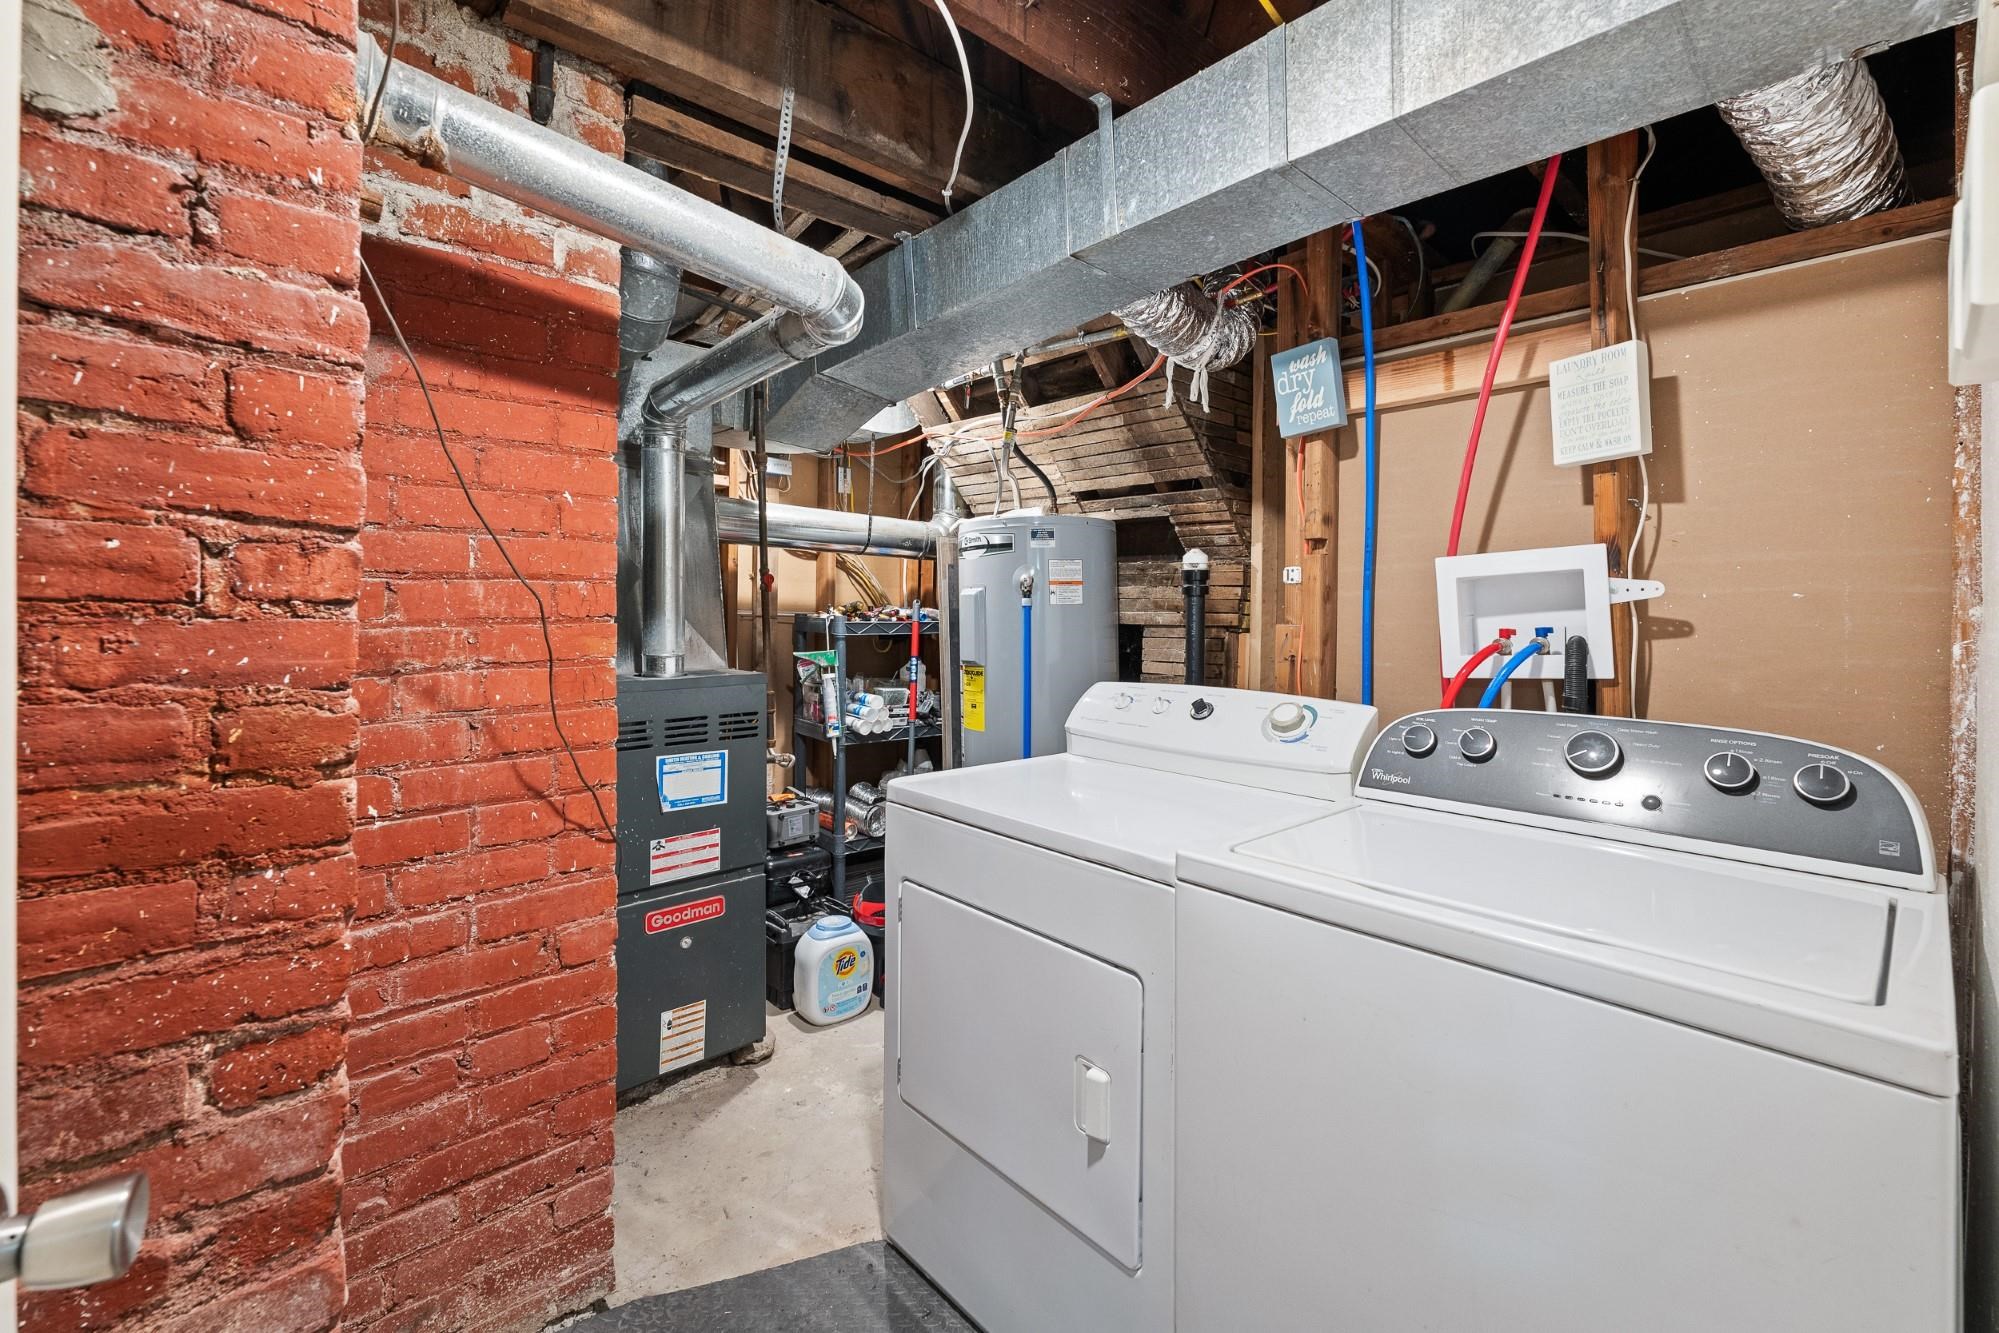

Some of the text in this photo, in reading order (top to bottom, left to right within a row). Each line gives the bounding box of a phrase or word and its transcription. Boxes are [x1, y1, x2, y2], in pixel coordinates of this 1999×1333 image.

[1289, 345, 1327, 372] wash
[1556, 347, 1627, 375] LAUNDRY ROOM
[1277, 368, 1315, 395] dry
[1558, 376, 1629, 400] MEASURE THE SOAP
[1289, 385, 1325, 423] fold
[1296, 405, 1336, 425] repeat
[1807, 752, 1840, 760] PRESOAK
[1372, 770, 1411, 784] Whirlpool
[650, 902, 721, 928] Goodman
[836, 954, 856, 976] Tide
